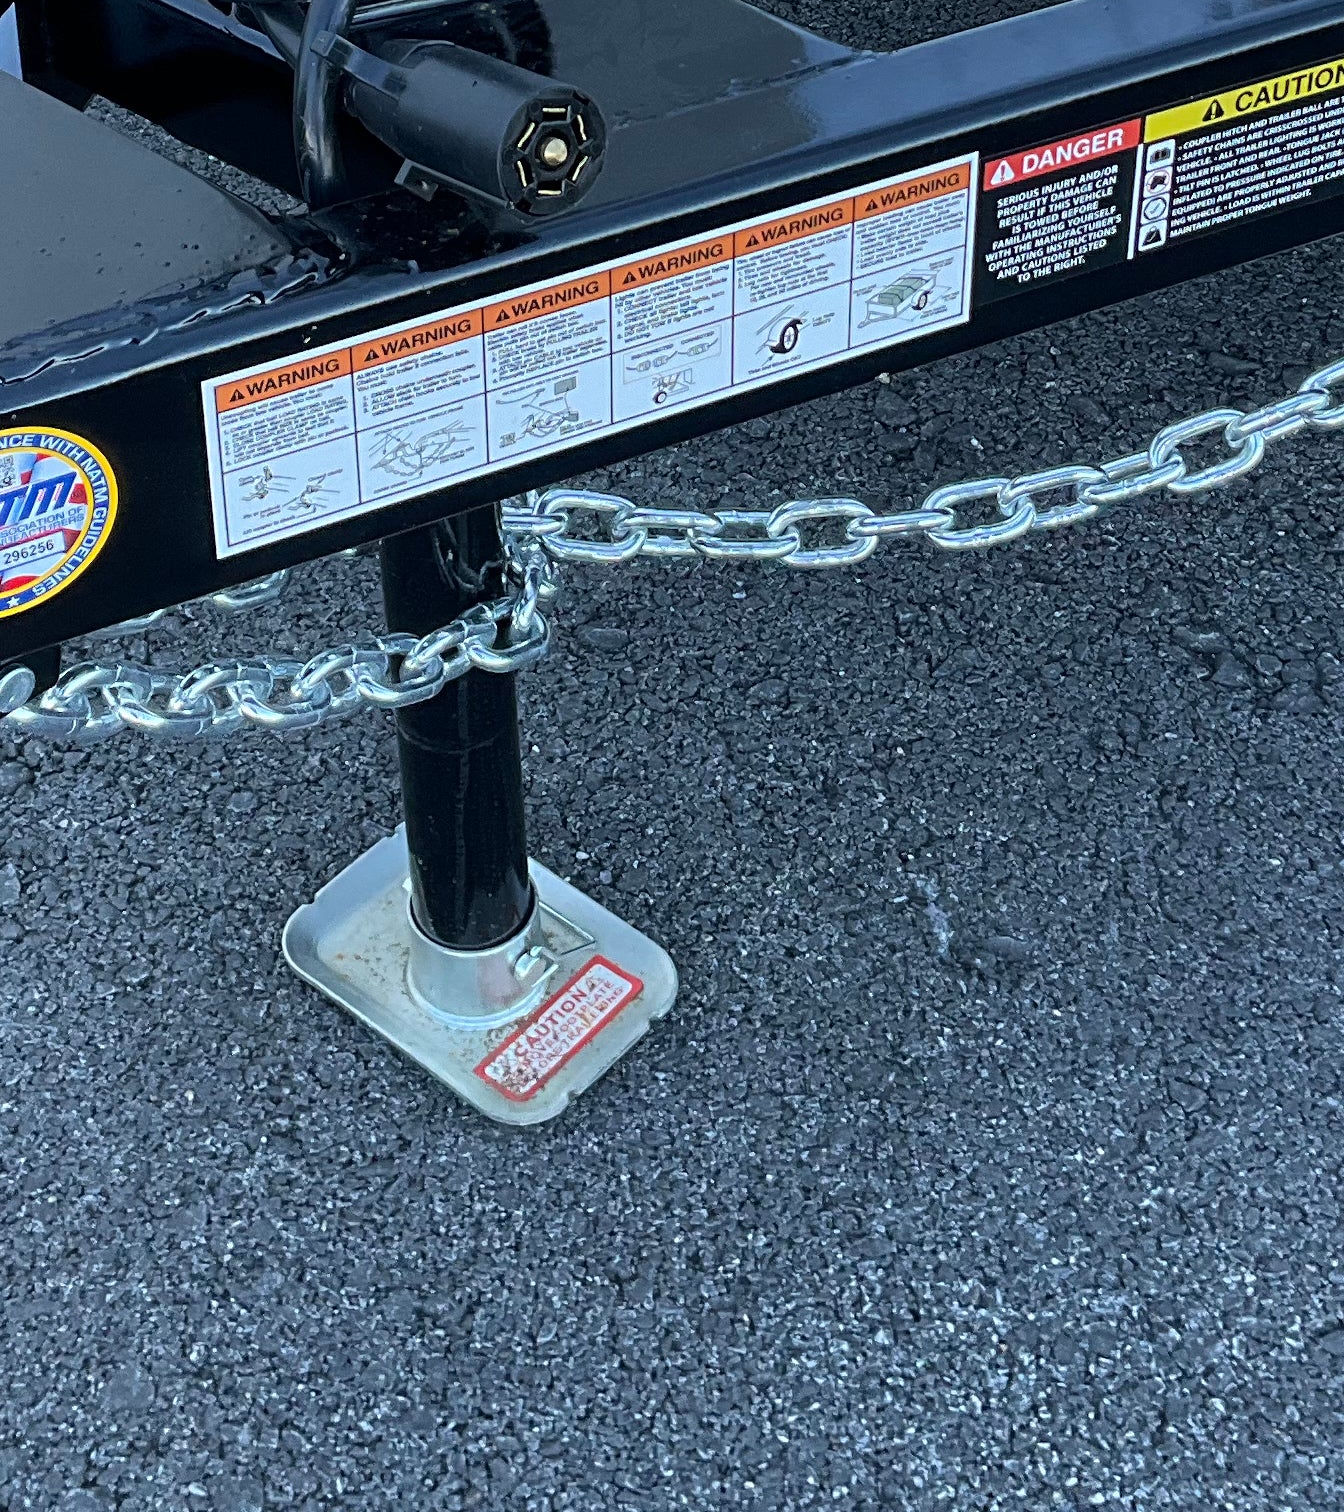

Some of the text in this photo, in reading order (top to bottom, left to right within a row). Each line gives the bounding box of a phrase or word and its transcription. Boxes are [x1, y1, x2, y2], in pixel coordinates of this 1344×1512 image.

[1183, 132, 1221, 149] COUPLER
[1222, 124, 1247, 138] HITCH
[1248, 119, 1267, 130] AND
[1268, 109, 1301, 124] TRAILER
[1302, 103, 1322, 115] BALL
[1324, 97, 1340, 108] ARE
[1218, 125, 1316, 160] ALL TRAILER LIGHTING IS
[1022, 128, 1123, 174] DANGER
[1182, 145, 1213, 160] SAFETY
[1214, 136, 1245, 151] CHAINS
[1246, 130, 1263, 142] ARE
[880, 173, 960, 209] WARNING
[997, 164, 1118, 208] SERIOUS INJURY AND/OR
[997, 175, 1117, 218] PROPERTY DAMAGE CAN
[761, 208, 844, 243] WARNING
[999, 186, 1113, 228] RESULT IF THIS VEHICLE
[1012, 201, 1098, 234] IS TOWED BEFORE
[1170, 220, 1210, 238] MAINTAIN
[1211, 209, 1243, 225] PROPER
[1244, 199, 1277, 215] TONGUE
[992, 205, 1116, 250] FAMILIARIZING YOURSELF
[637, 243, 724, 281] WARNING
[985, 247, 1011, 262] WITH
[1013, 241, 1032, 254] THE
[988, 225, 1117, 271] OPERATING INSTRUCTIONS
[997, 239, 1107, 279] AND CAUTIONS LISTED
[1017, 255, 1085, 283] TO THE RIGHT.
[511, 281, 599, 317] WARNING
[380, 318, 472, 357] WARNING
[246, 357, 341, 397] WARNING
[40, 435, 86, 462] WITH
[81, 456, 109, 504] NATM
[65, 506, 85, 519] OF
[3, 539, 55, 564] 296256
[32, 506, 108, 598] GUIDELINES
[510, 987, 588, 1058] CAUTION
